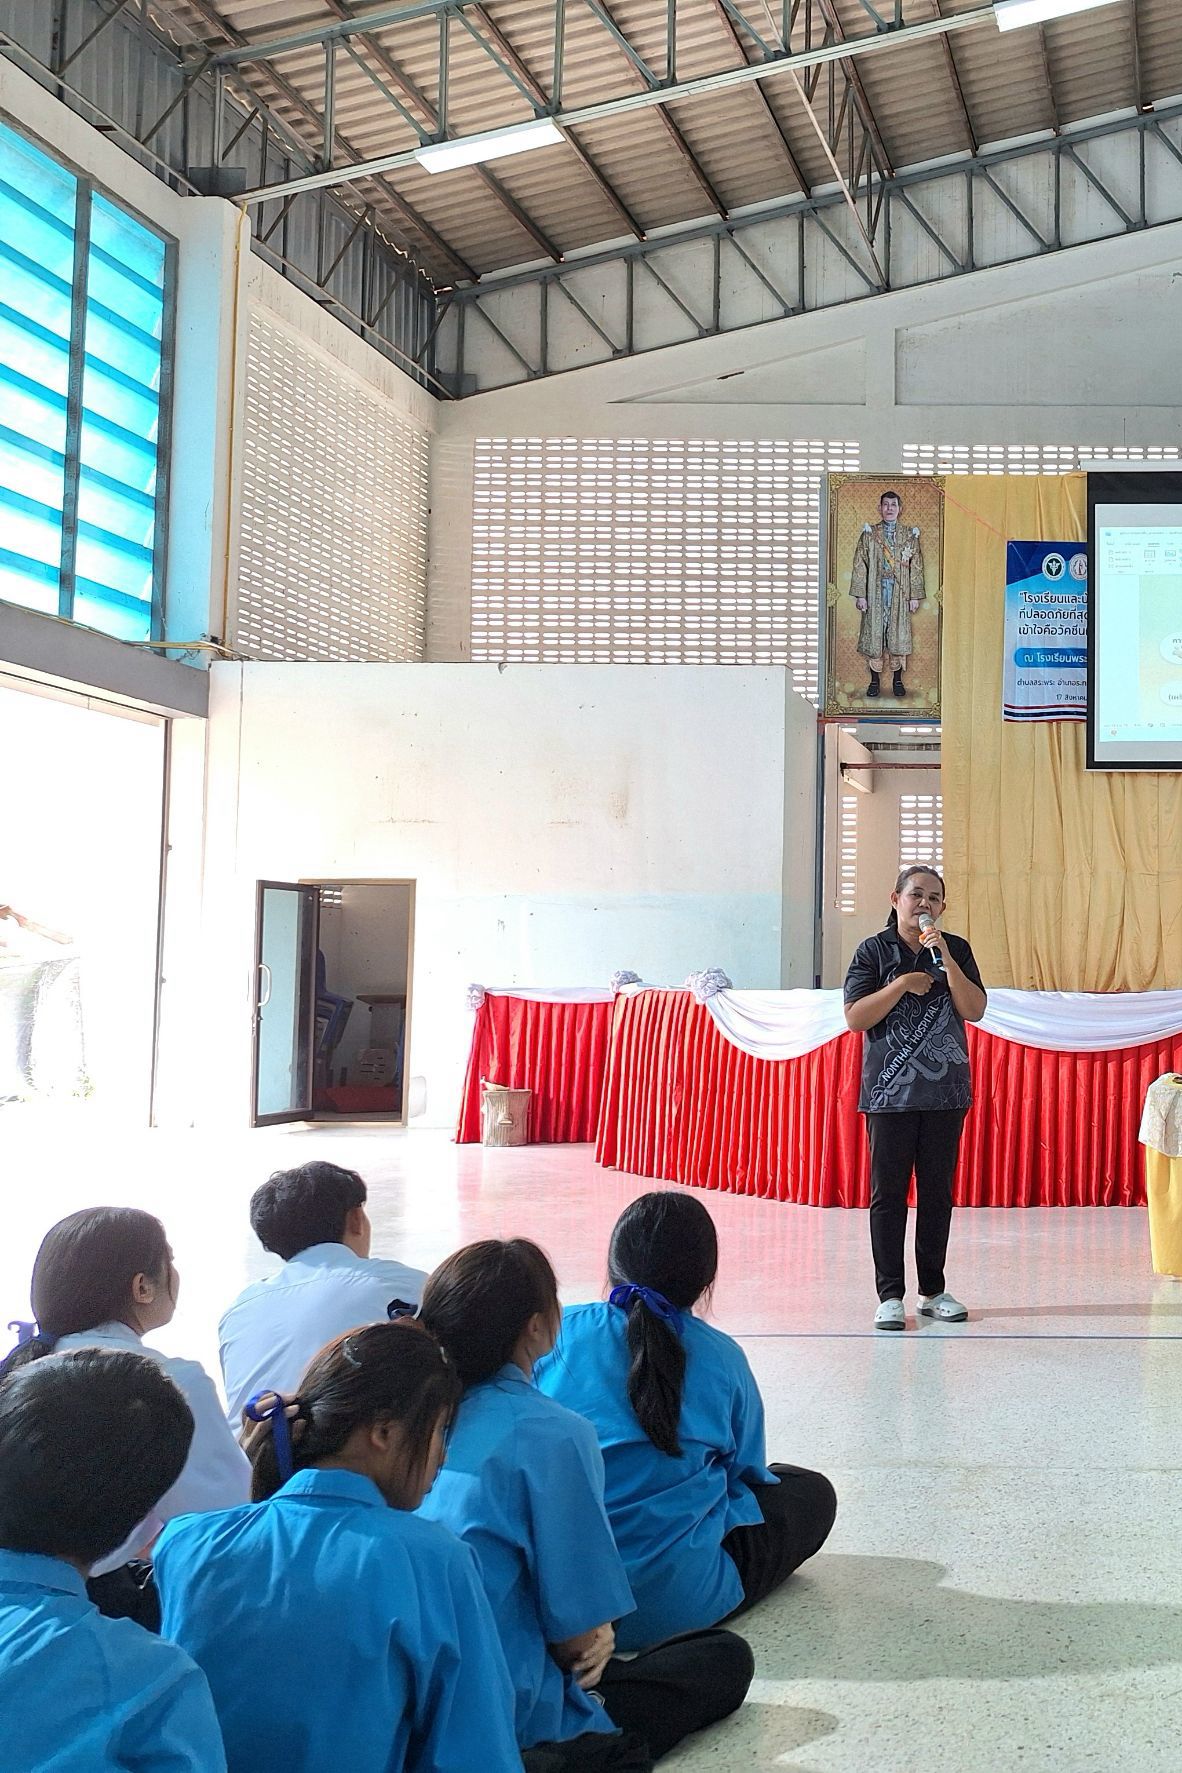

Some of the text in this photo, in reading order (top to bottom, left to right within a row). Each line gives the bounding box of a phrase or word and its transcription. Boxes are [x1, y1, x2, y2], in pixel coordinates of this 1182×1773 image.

[1018, 624, 1088, 635] เข้าใจคือวัคซีน
[881, 1005, 940, 1082] NONTHAI HOSPITAL
